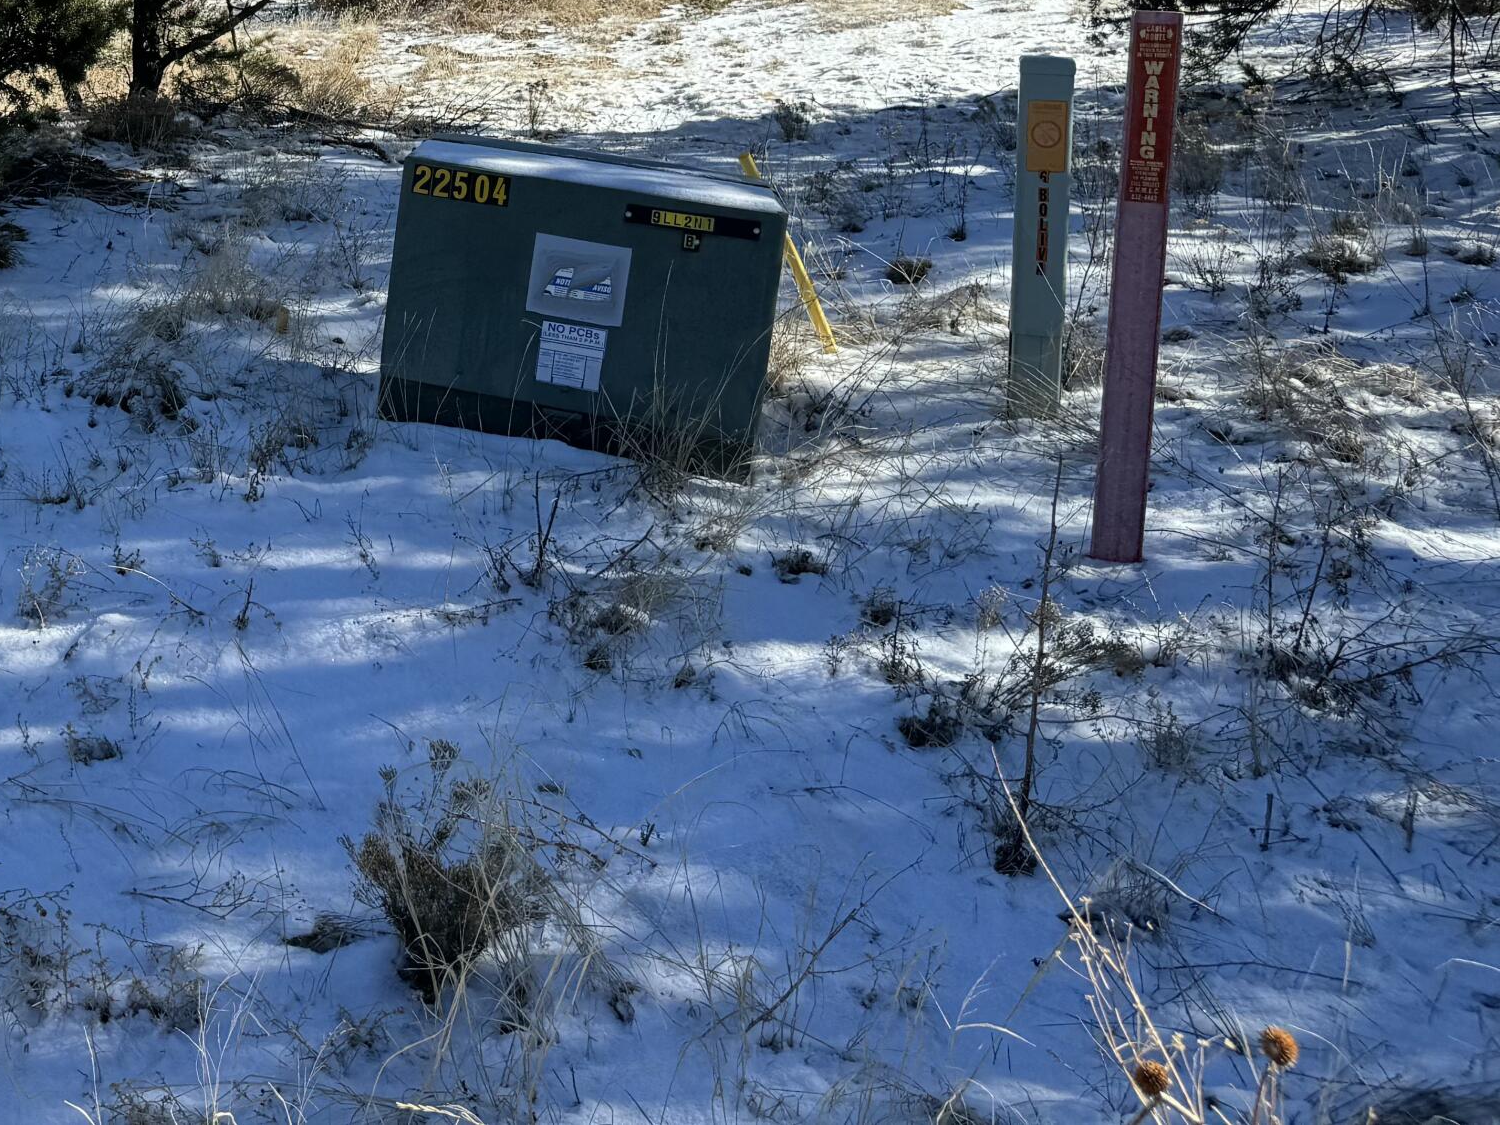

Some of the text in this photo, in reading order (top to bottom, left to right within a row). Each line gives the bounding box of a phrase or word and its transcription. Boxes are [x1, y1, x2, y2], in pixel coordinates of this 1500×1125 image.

[1140, 60, 1164, 160] WARNING
[413, 165, 507, 206] 22504
[652, 211, 712, 230] 9LL2N1
[591, 283, 612, 293] AVISO
[547, 322, 600, 340] NO PCBs
[561, 334, 578, 342] THAN
